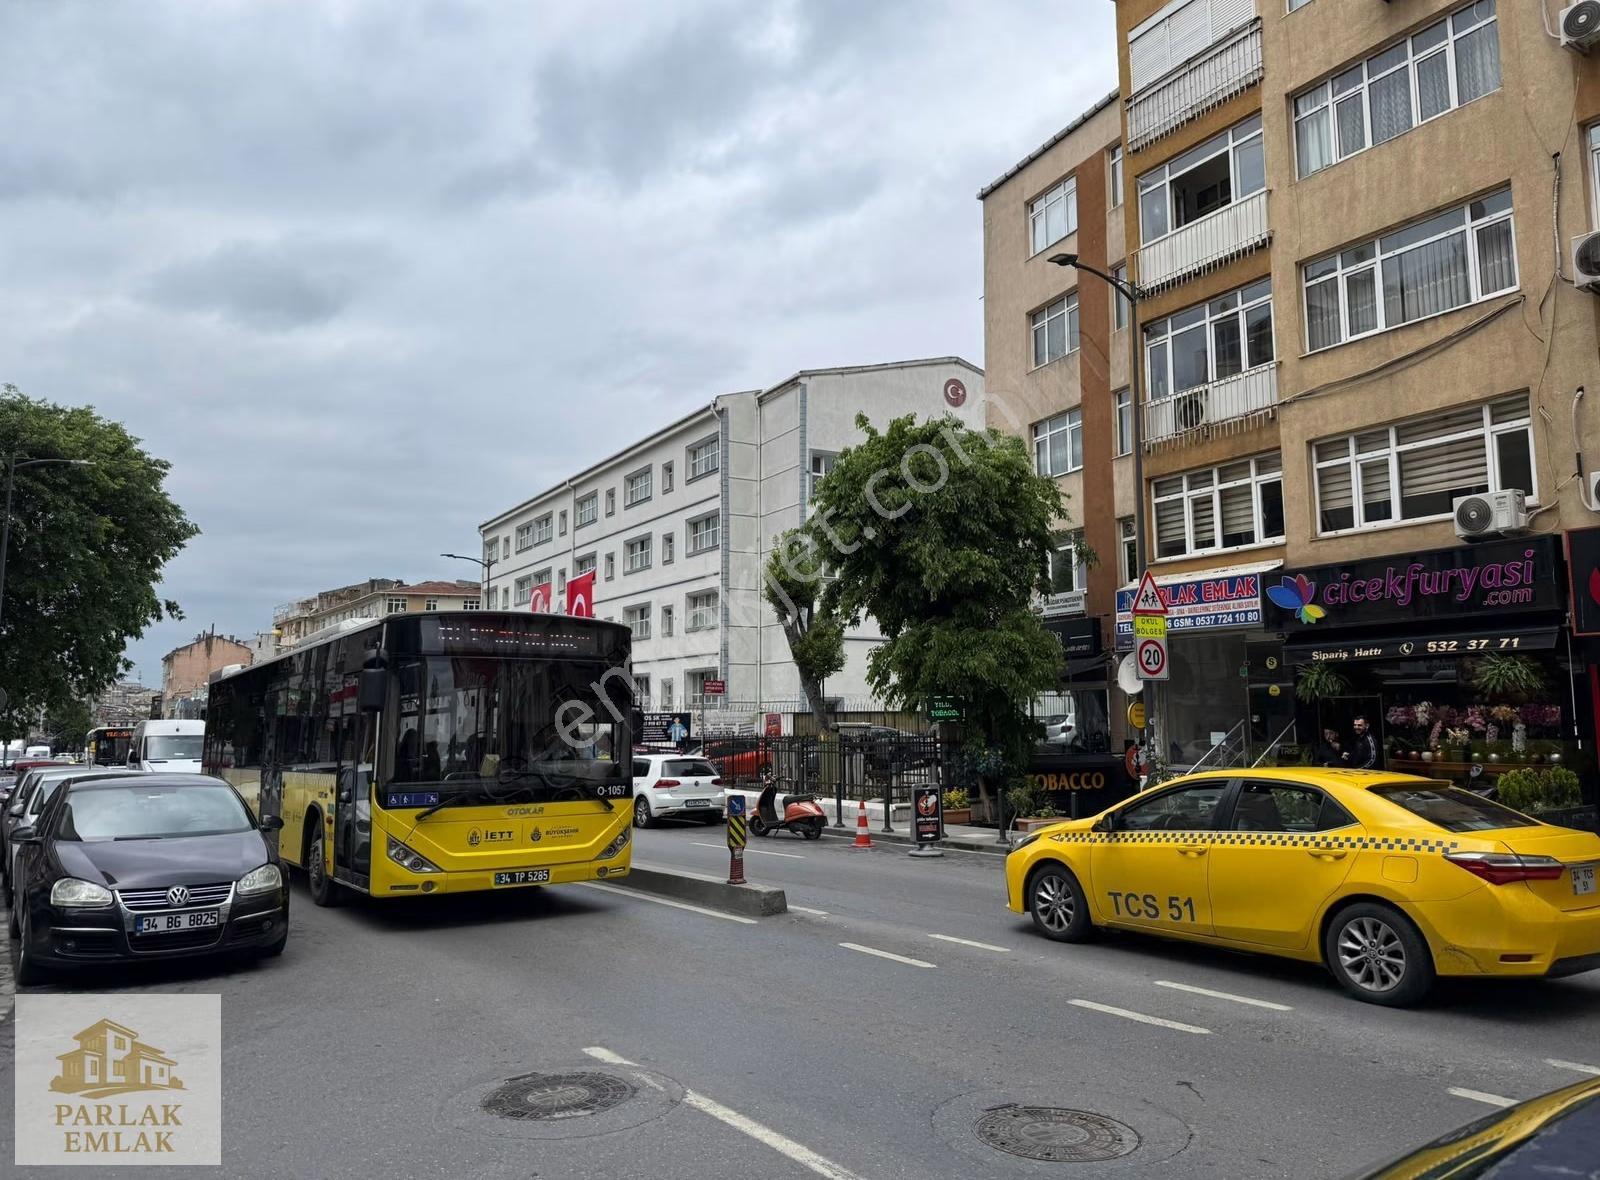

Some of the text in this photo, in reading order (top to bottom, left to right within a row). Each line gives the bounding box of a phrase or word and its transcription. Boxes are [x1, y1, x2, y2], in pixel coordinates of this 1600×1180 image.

[1323, 549, 1535, 606] cicekfuryasi
[1158, 577, 1257, 606] RLAK EMLAK
[1482, 587, 1532, 606] .com
[1173, 618, 1194, 628] GSM:
[1195, 615, 1215, 626] 0537
[1218, 613, 1233, 624] 724
[1235, 612, 1246, 622] 10
[1249, 611, 1259, 621] 80
[1144, 649, 1160, 665] 20
[1311, 637, 1520, 661] Sipariş Hattı 532 37 71
[597, 785, 626, 796] O-1057
[507, 806, 544, 816] OTOKAR
[500, 870, 548, 884] 34 TP 5285
[1107, 891, 1195, 921] TCS 51
[143, 912, 217, 931] 34 BG 8825
